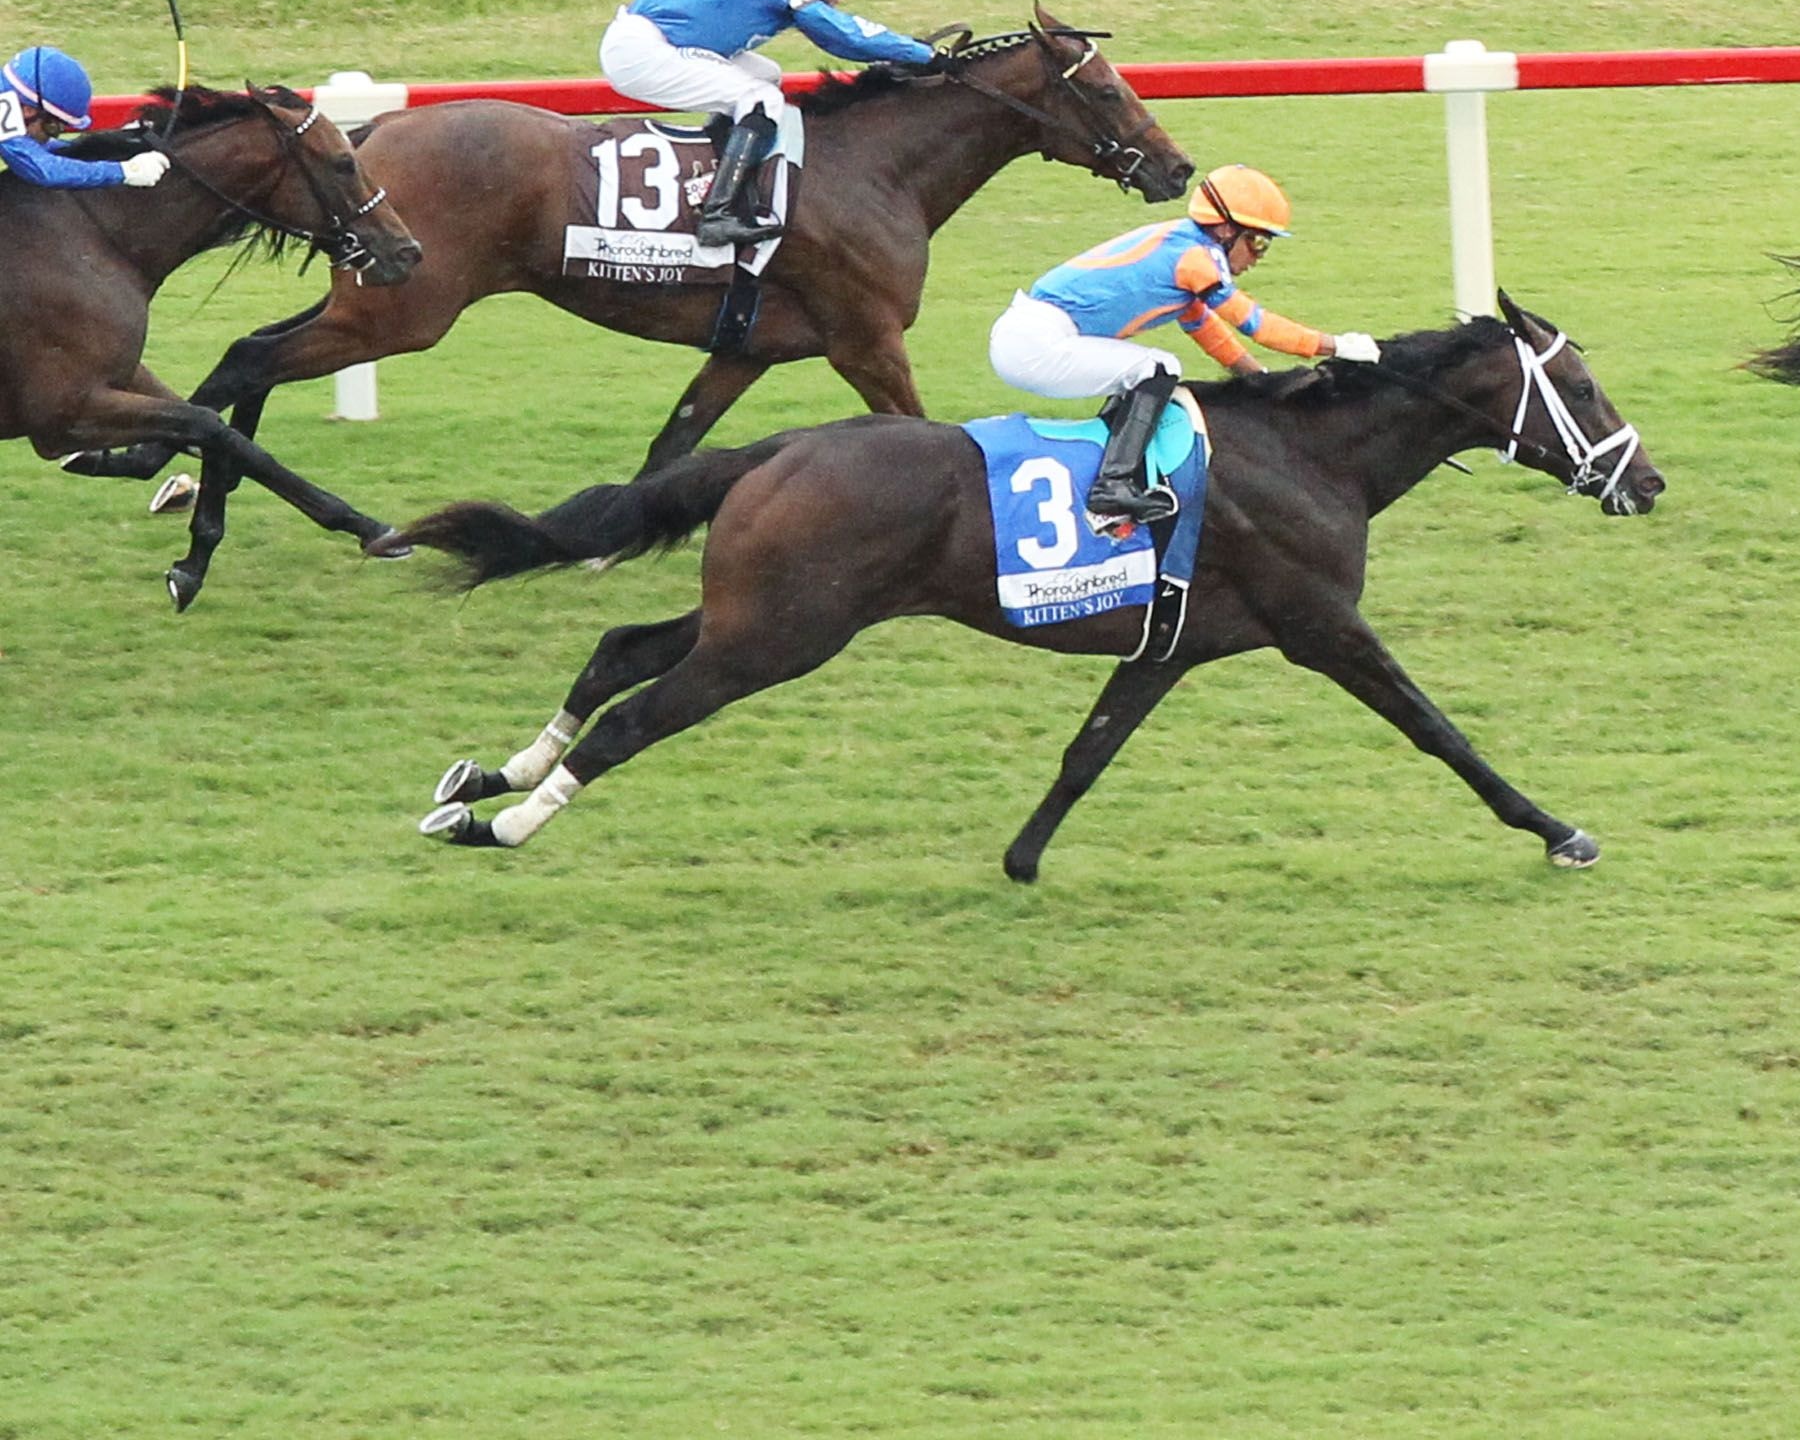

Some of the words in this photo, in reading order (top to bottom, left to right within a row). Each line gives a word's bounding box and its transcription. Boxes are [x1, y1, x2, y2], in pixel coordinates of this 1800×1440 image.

[590, 132, 682, 230] 13
[593, 237, 694, 259] Thoroughbred
[587, 260, 656, 282] KITTEN'S
[656, 266, 685, 283] JOY
[1009, 456, 1080, 570] 3
[1022, 598, 1094, 626] KITTEN'S
[1096, 591, 1125, 613] JOY
